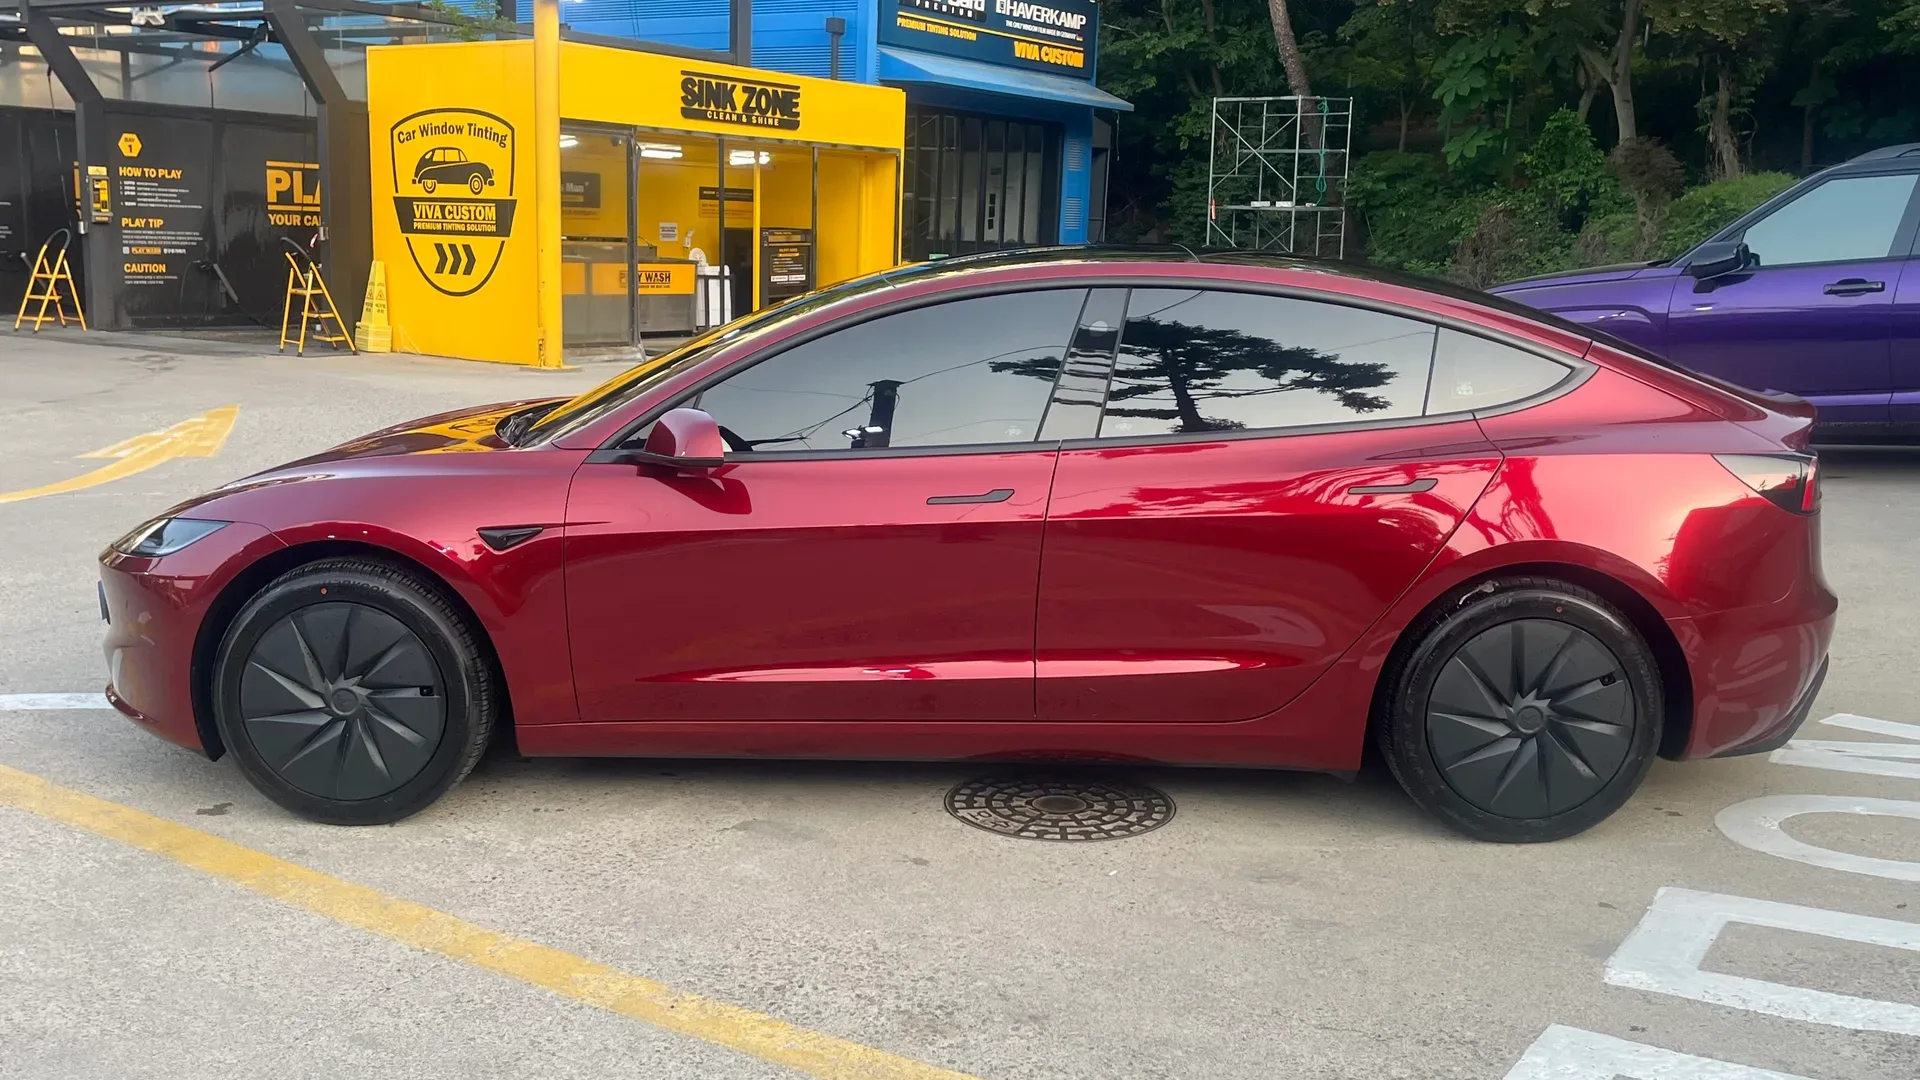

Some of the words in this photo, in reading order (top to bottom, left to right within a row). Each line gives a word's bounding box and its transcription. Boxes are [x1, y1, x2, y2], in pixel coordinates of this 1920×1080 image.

[1005, 0, 1087, 29] HAVERKAMP
[897, 17, 926, 31] PREMIUM
[927, 23, 948, 36] TINTING
[949, 28, 977, 41] SOLUTION
[1013, 41, 1040, 61] VIVA
[1041, 46, 1084, 68] CUSTOM
[681, 77, 737, 111] SINK
[742, 85, 800, 118] ZONE
[707, 111, 737, 121] CLEAN
[741, 115, 747, 123] &
[752, 115, 779, 126] SHINE
[397, 130, 416, 144] Car
[419, 122, 464, 137] Window
[467, 123, 508, 148] Tinting
[119, 166, 142, 177] HOW
[143, 168, 157, 178] TO
[158, 169, 182, 179] PLAY
[268, 213, 301, 226] YOUR
[303, 215, 321, 227] CA
[413, 205, 442, 219] VIVA
[445, 205, 496, 220] CUSTOM
[121, 217, 146, 227] PLAY
[148, 218, 164, 228] TIP
[413, 222, 442, 230] PREMIUM
[443, 222, 466, 231] TINTING
[466, 223, 496, 232] SOLUTION
[124, 263, 166, 273] CAUTION
[645, 272, 671, 282] WASH
